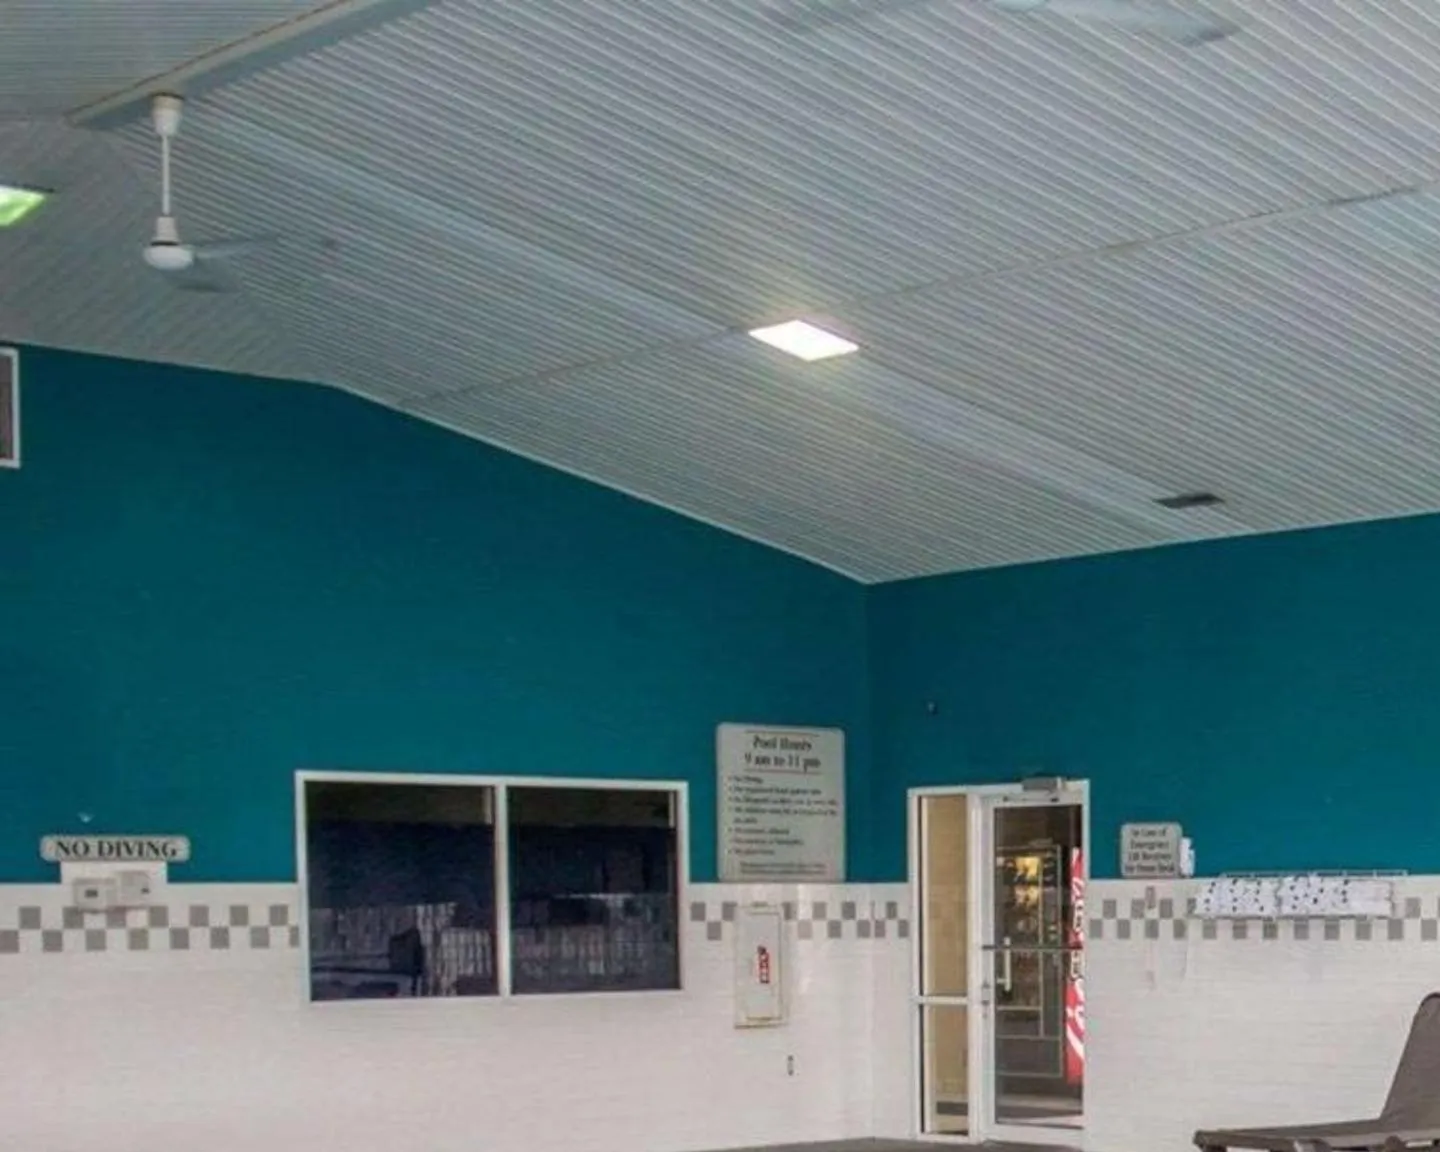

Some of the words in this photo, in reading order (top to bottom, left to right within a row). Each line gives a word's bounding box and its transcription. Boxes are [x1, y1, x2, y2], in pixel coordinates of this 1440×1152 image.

[753, 734, 777, 749] Pool
[755, 755, 771, 765] am
[774, 755, 786, 766] to
[788, 753, 800, 767] 11
[803, 757, 821, 774] pm
[56, 840, 90, 857] NO
[98, 840, 178, 857] DIVING
